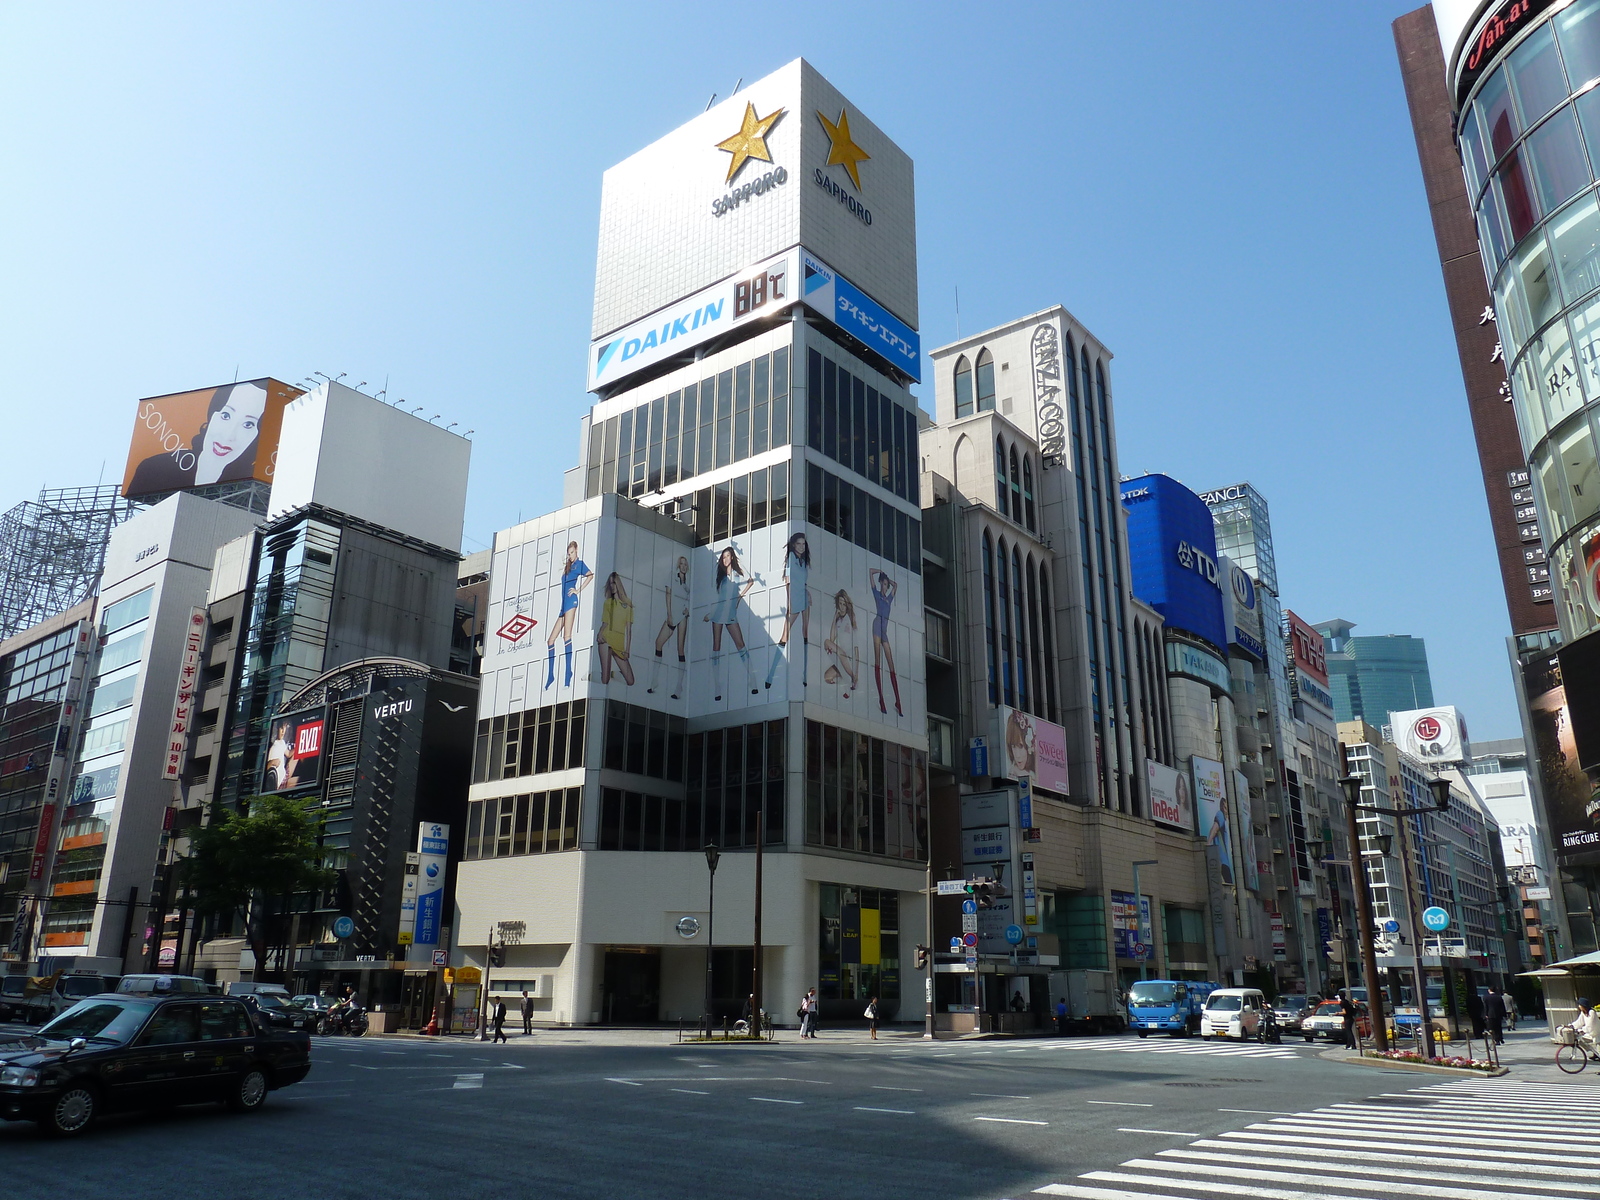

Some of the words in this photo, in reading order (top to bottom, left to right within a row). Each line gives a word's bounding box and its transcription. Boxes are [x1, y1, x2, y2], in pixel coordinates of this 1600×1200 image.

[712, 166, 787, 217] SAPPORO
[814, 168, 872, 226] SAPPORO
[805, 257, 832, 281] DAIKIN
[621, 298, 724, 362] DAIKIN
[838, 295, 917, 360] ダイキンエアコン
[1034, 324, 1061, 402] GINZA
[139, 403, 195, 471] SONOKO
[1039, 403, 1066, 471] CORE
[1125, 487, 1149, 498] TDK
[1199, 485, 1246, 506] FANCL
[1295, 626, 1328, 676] THK
[172, 632, 201, 734] ニューギンザビル
[374, 699, 413, 719] VERTU
[1420, 742, 1445, 757] LG
[48, 777, 58, 798] CAFE
[1152, 797, 1180, 823] InRed
[973, 832, 1003, 842] 新生銀行
[1563, 836, 1581, 847] RING
[1580, 832, 1600, 844] CUBE
[422, 896, 435, 942] 新生銀行
